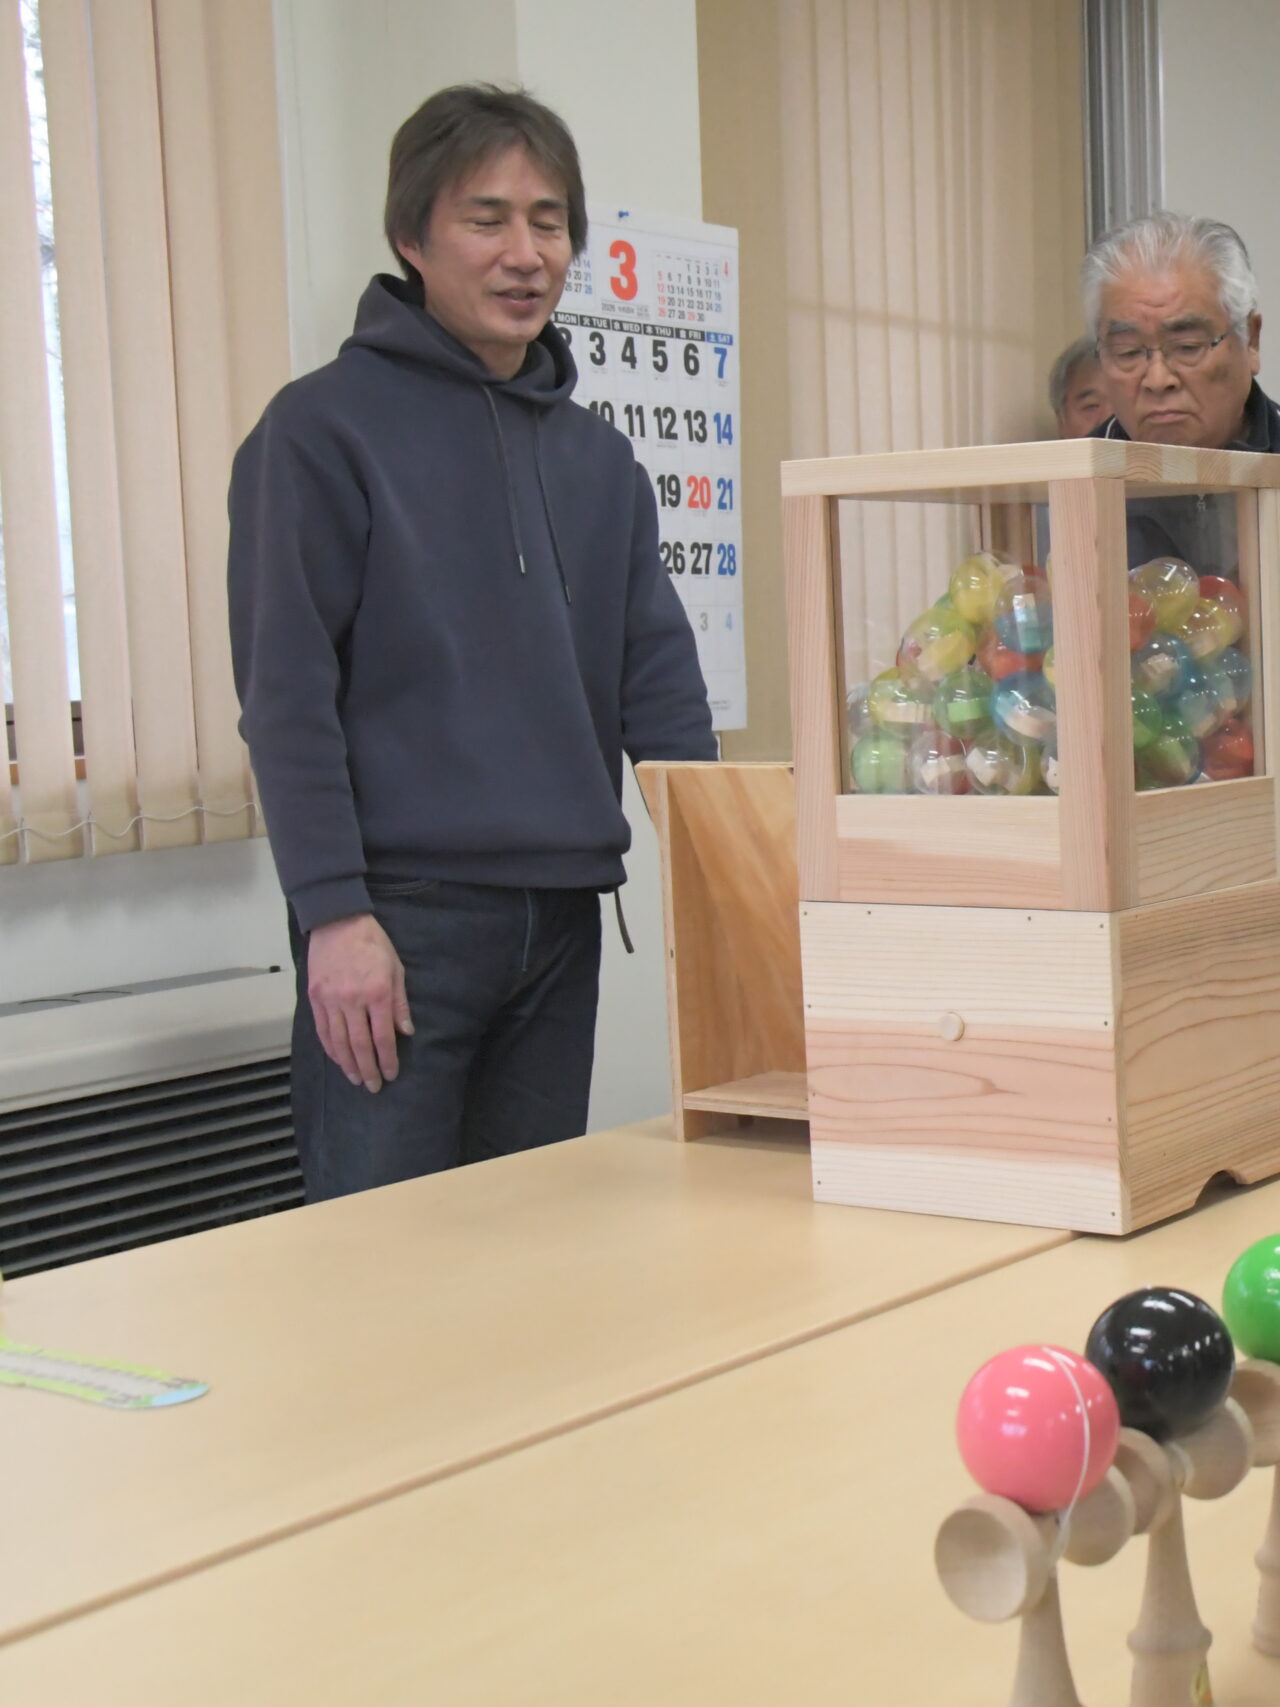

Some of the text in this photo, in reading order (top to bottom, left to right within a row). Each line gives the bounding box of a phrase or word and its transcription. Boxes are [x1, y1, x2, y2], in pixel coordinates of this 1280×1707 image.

[610, 240, 638, 300] 3
[574, 282, 582, 293] 27
[667, 284, 675, 294] 13
[676, 285, 684, 295] 14
[686, 287, 694, 297] 15
[557, 313, 577, 324] MON
[668, 308, 676, 318] 27
[592, 318, 609, 328] TUE
[622, 322, 640, 332] WED
[655, 326, 671, 337] THU
[689, 330, 701, 340] FRI
[717, 335, 731, 344] SAT
[589, 331, 606, 366] 3
[621, 336, 637, 370] 4
[652, 339, 668, 373] 5
[683, 343, 700, 376] 6
[713, 347, 728, 379] 7
[624, 404, 645, 438] 11
[653, 406, 678, 440] 12
[683, 409, 707, 443] 13
[713, 412, 733, 445] 14
[657, 474, 733, 510] 19 20 21
[660, 541, 736, 576] 26 27 28
[700, 612, 708, 632] 3
